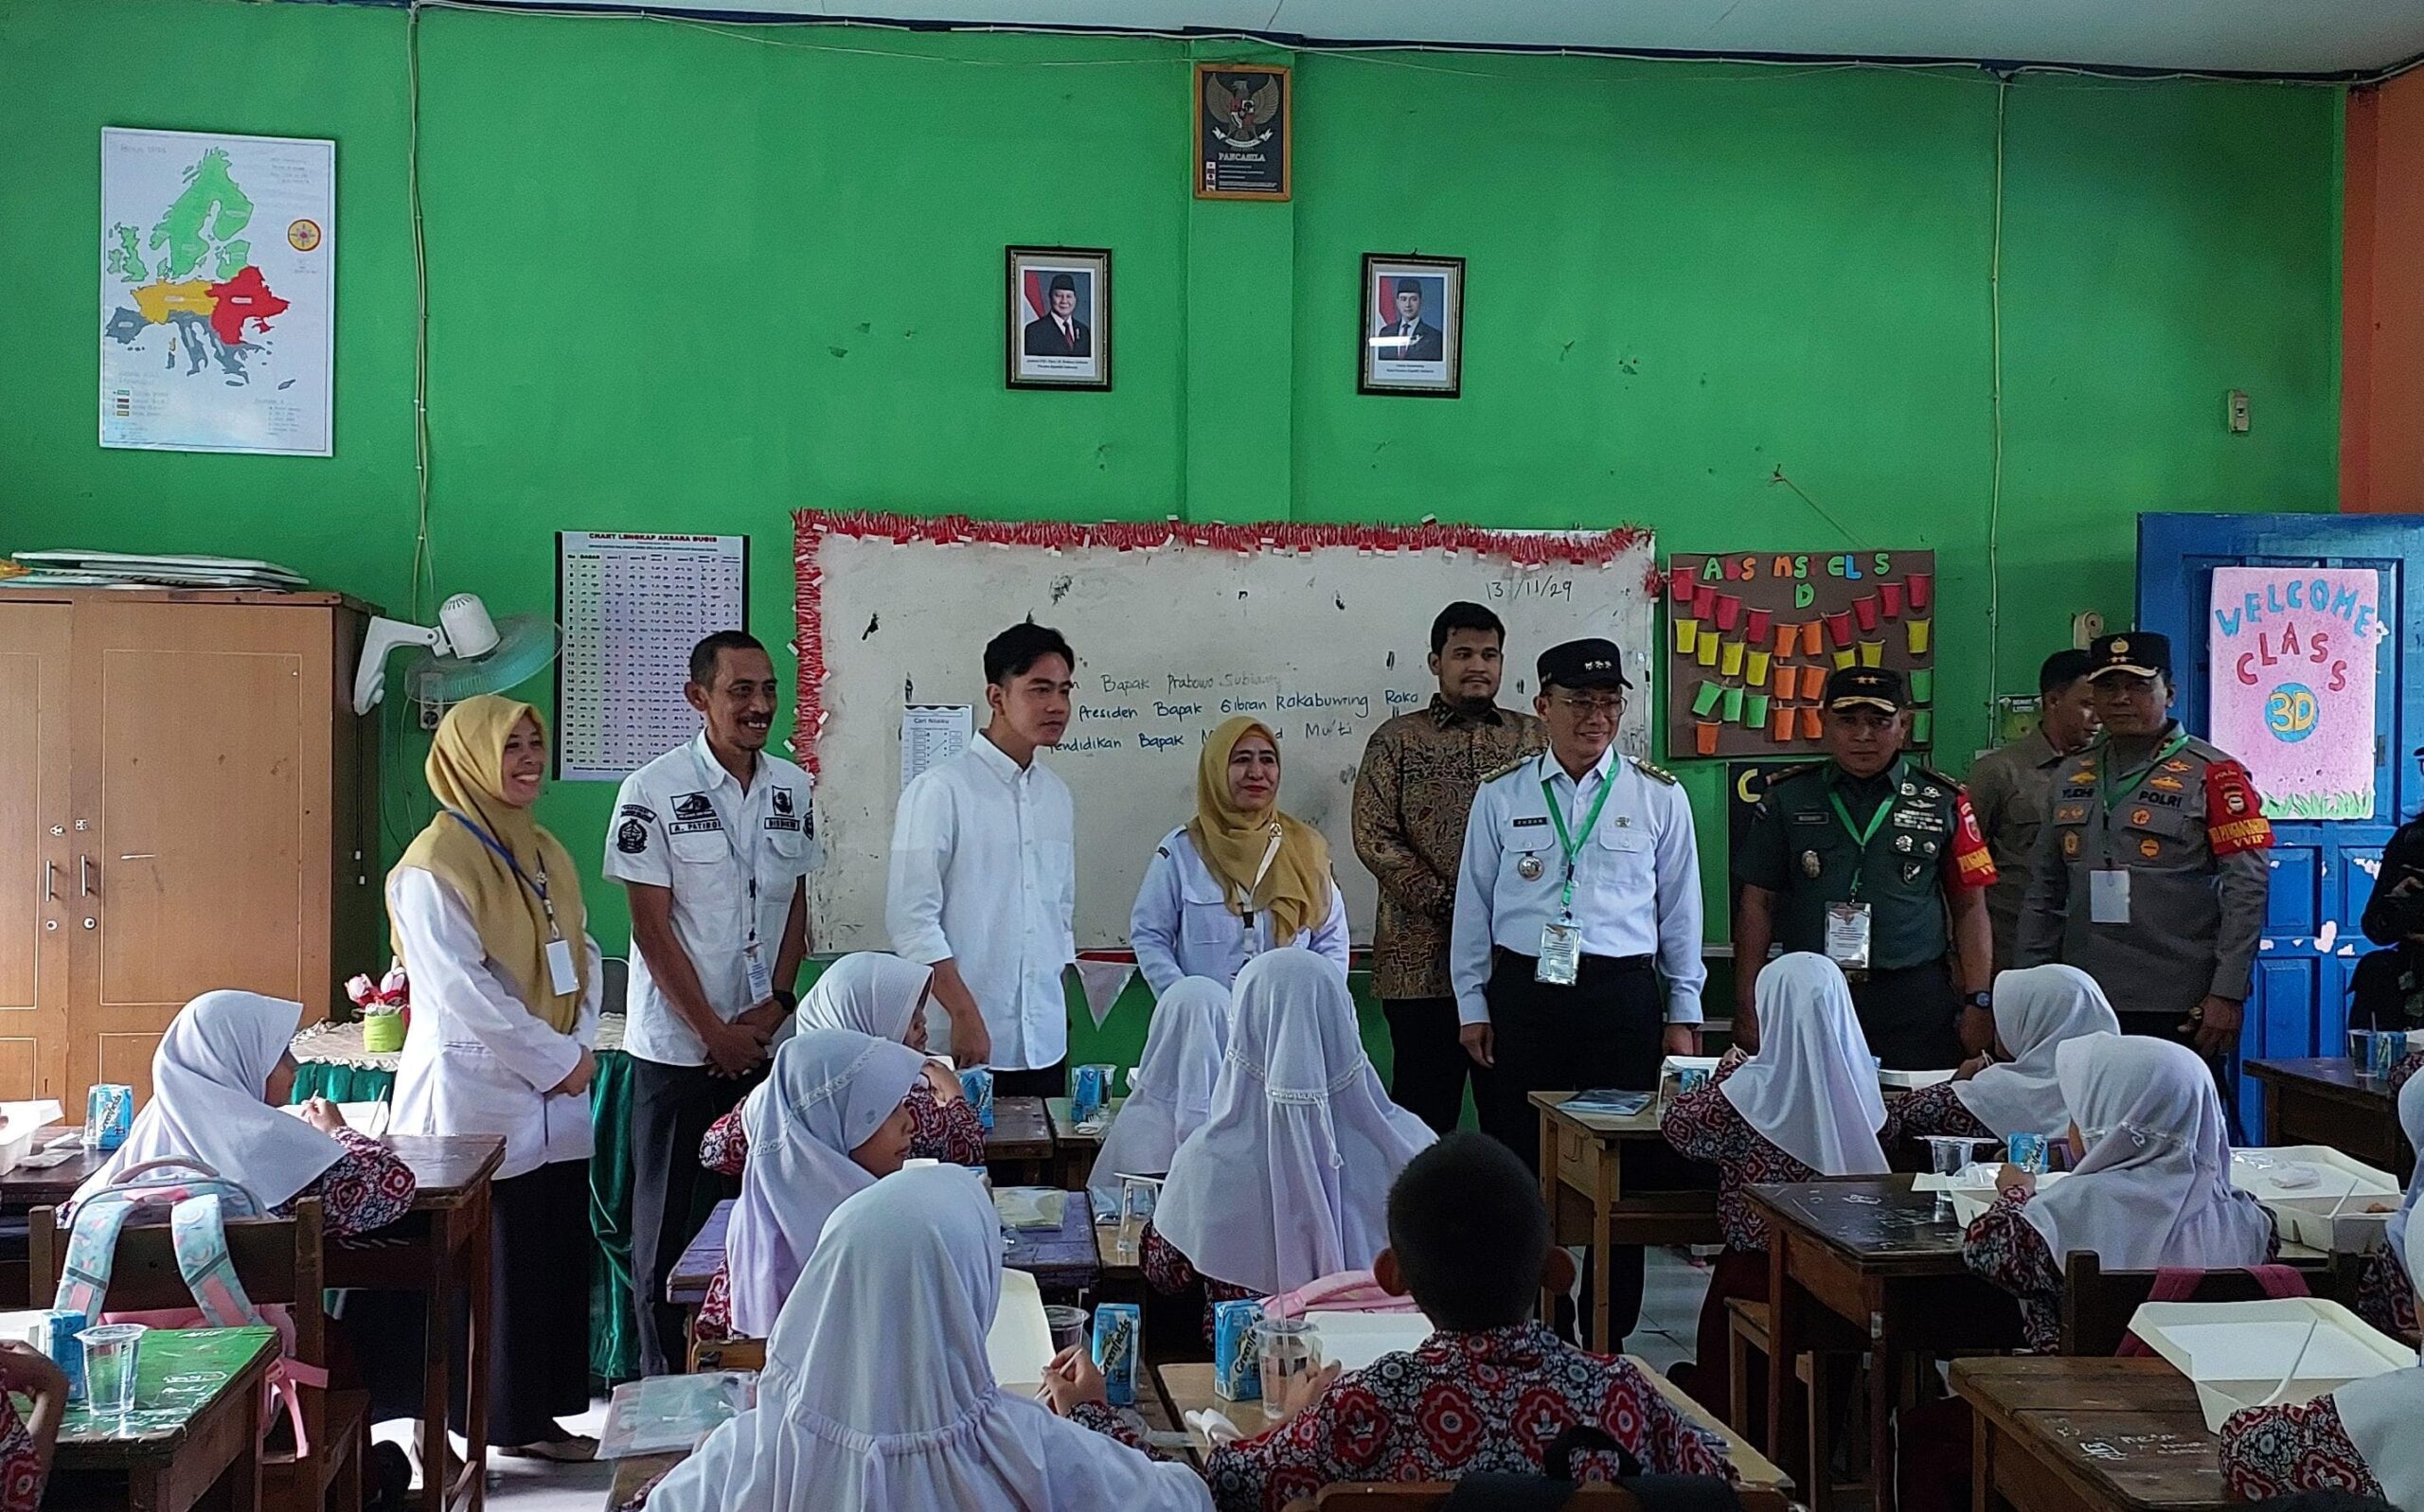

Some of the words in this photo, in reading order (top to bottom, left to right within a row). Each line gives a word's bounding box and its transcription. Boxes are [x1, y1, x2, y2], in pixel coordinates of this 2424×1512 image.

[2215, 578, 2375, 638] WELCOME
[2237, 621, 2347, 692] CLASS
[1099, 673, 1150, 696] Bapak
[1078, 704, 1138, 722] Presiden
[1153, 702, 1203, 722] Bapak
[2269, 691, 2315, 734] 3D
[1137, 731, 1185, 753] Bapak
[2139, 791, 2183, 809] POLRI
[2233, 834, 2265, 848] VVIP
